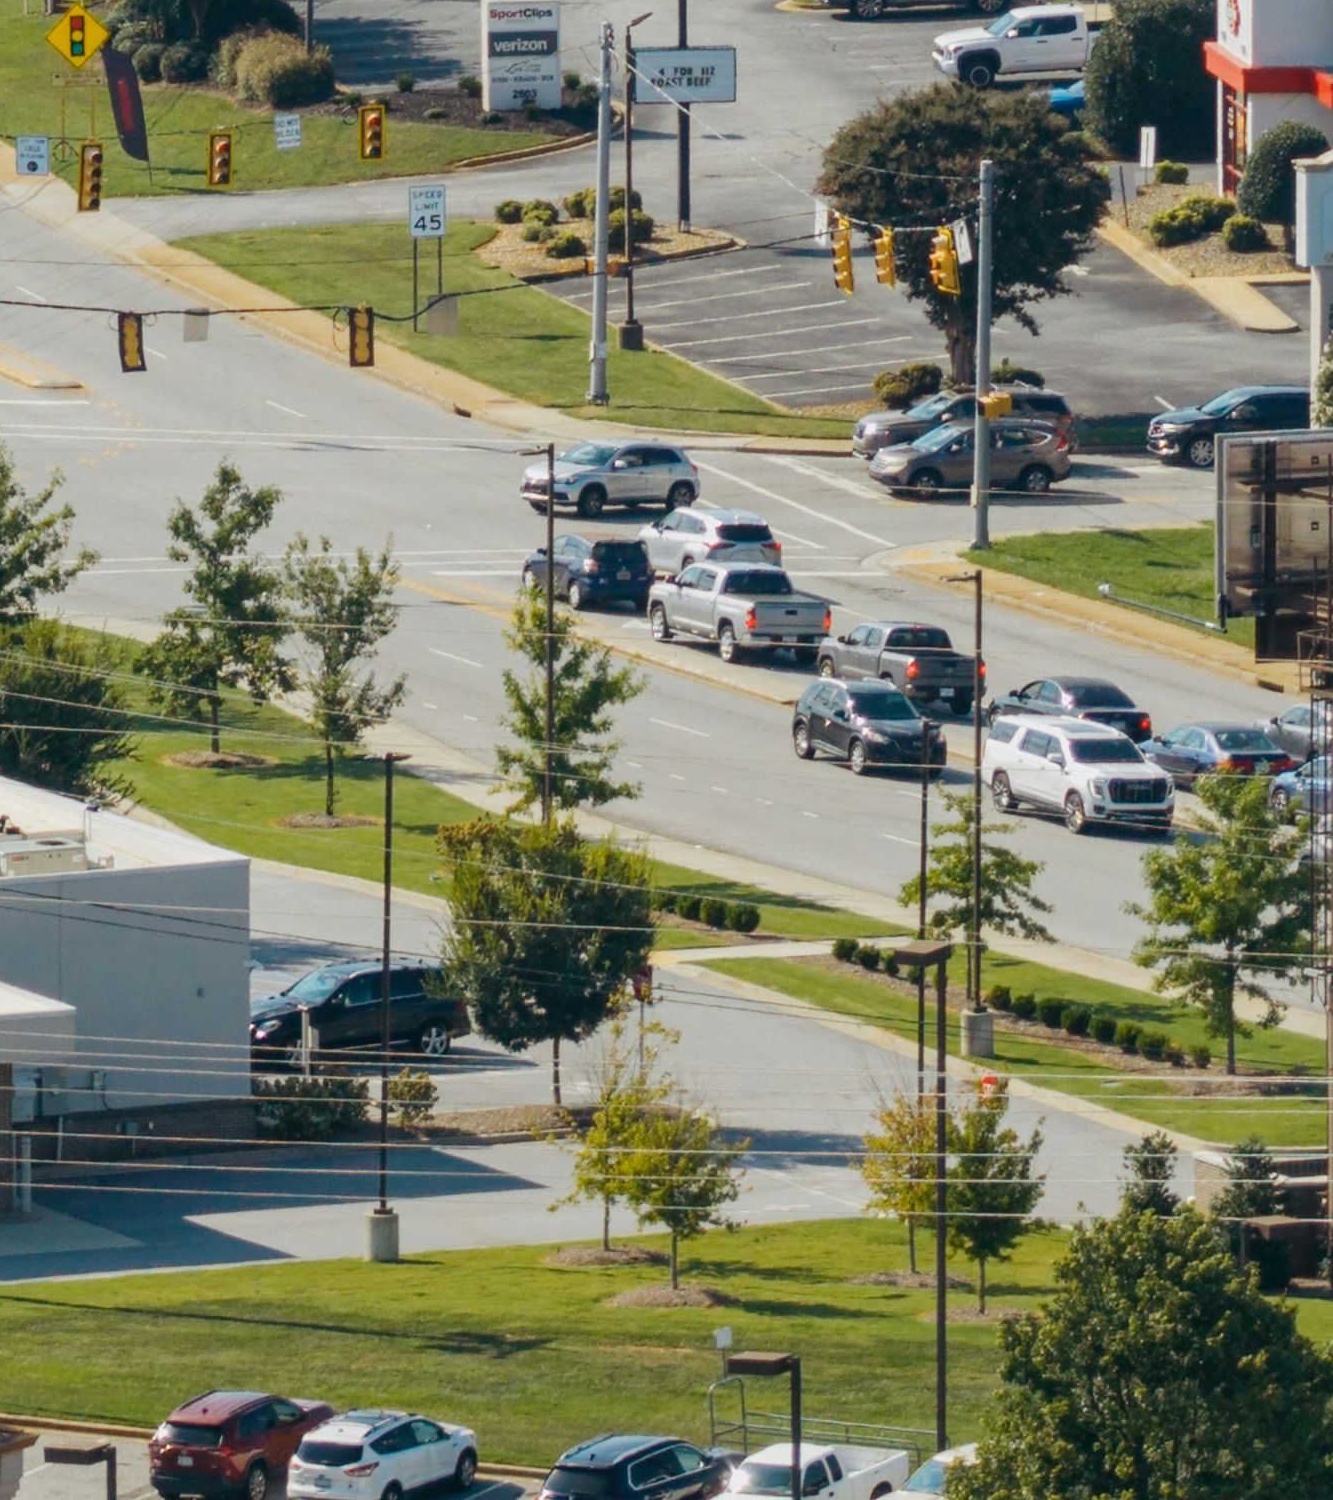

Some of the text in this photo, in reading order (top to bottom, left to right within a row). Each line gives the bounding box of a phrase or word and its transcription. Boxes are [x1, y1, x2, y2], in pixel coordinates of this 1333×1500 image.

[493, 38, 548, 52] verizon
[674, 67, 693, 76] FOR
[686, 76, 711, 87] BEEF
[277, 129, 300, 138] BLOCK
[412, 189, 443, 199] SPEED
[415, 202, 440, 210] LIMIT
[413, 214, 442, 231] 45
